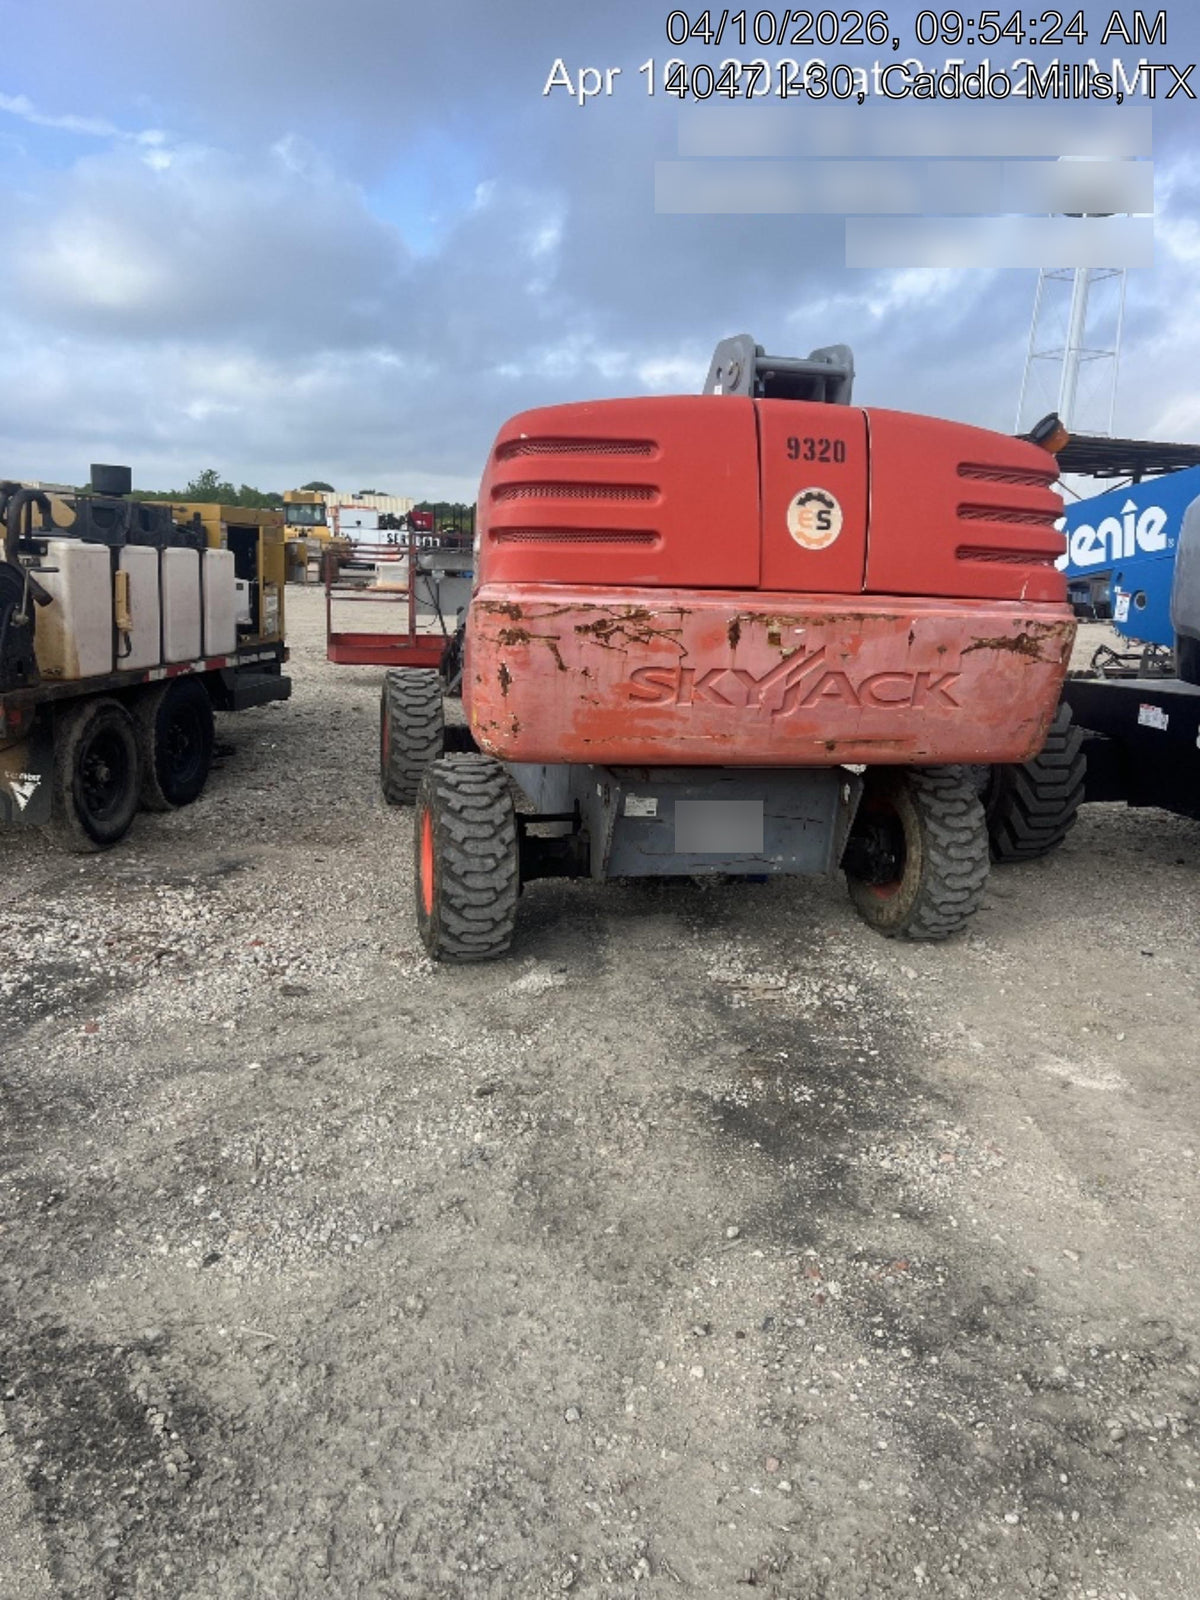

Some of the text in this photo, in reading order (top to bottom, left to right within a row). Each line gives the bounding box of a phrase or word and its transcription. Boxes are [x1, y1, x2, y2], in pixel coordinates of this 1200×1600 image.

[786, 436, 846, 463] 9320
[797, 508, 831, 530] ES
[628, 645, 963, 717] SKYJACK
